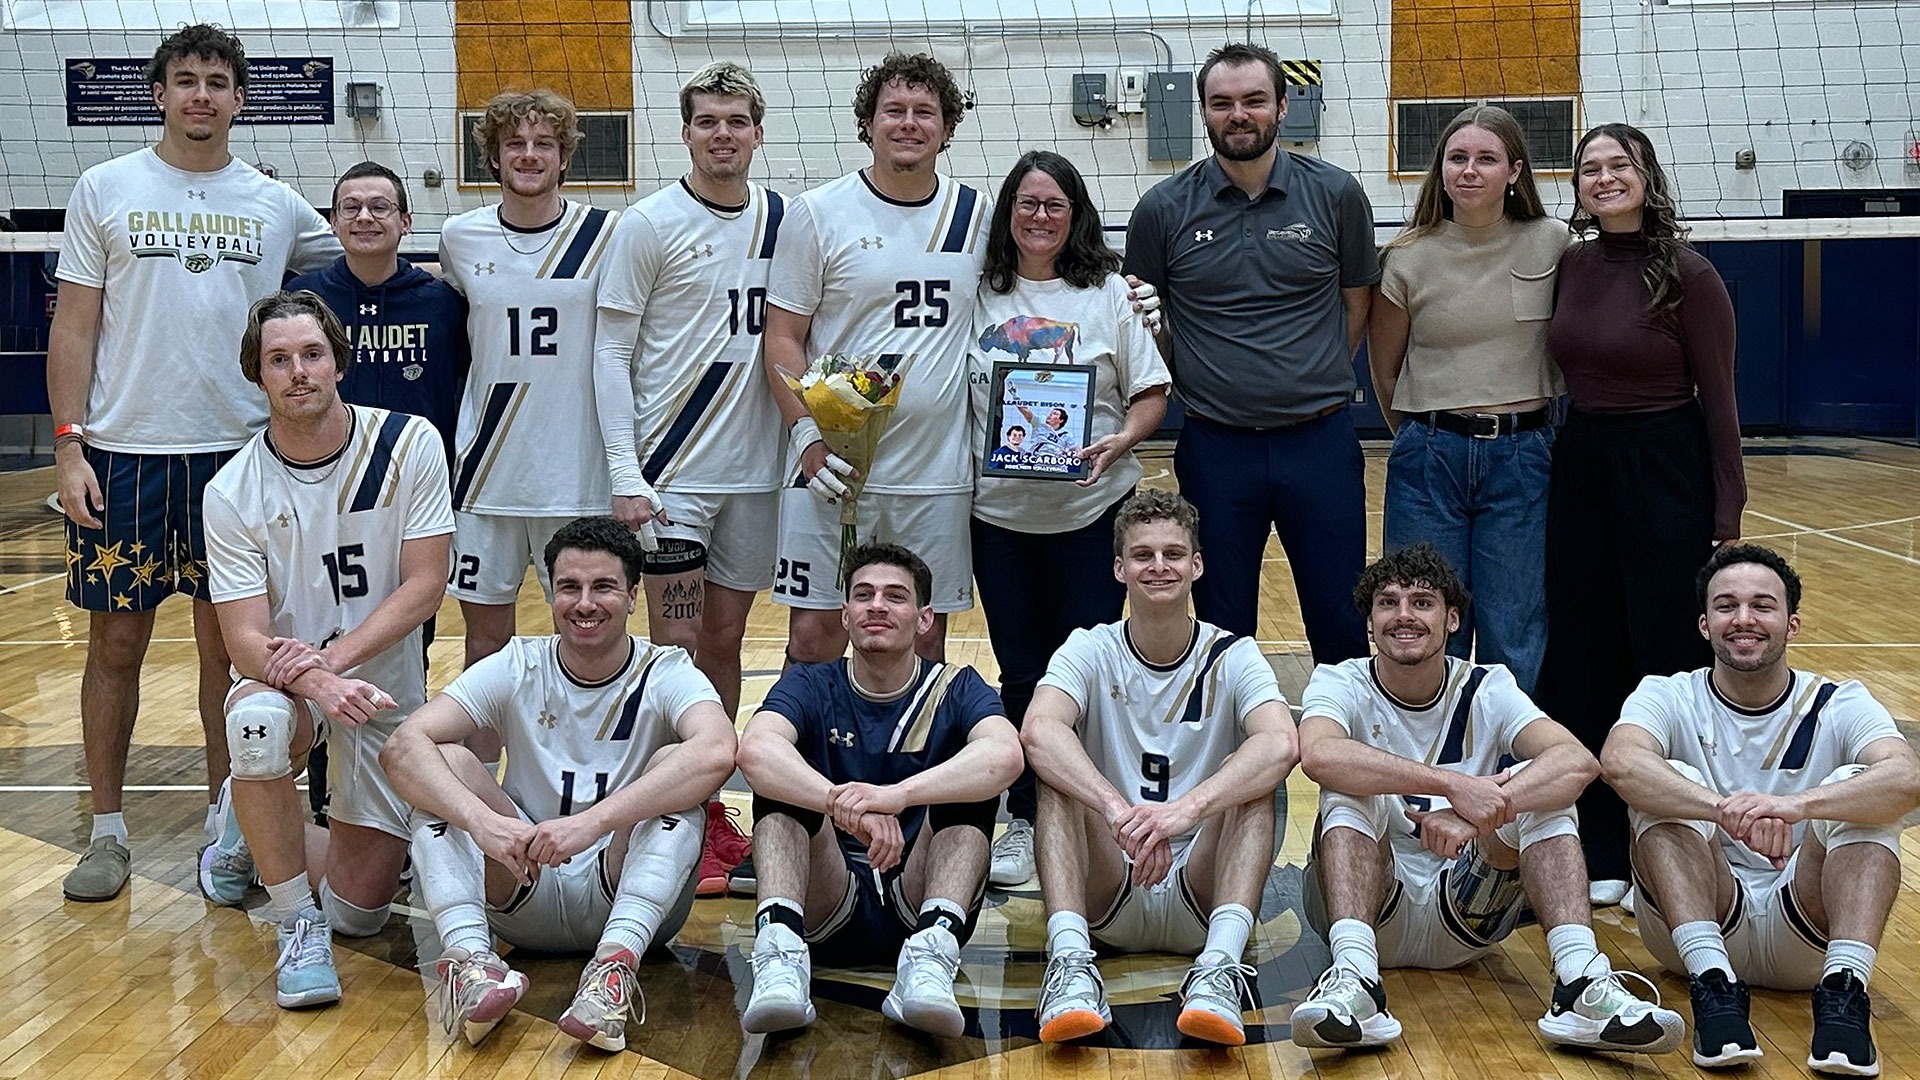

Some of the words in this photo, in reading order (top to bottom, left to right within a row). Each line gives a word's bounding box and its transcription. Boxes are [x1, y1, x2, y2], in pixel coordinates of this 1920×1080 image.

[128, 211, 264, 241] GALLAUDET
[129, 233, 263, 257] VOLLEYBALL
[728, 287, 767, 336] 10
[895, 279, 951, 328] 25
[506, 307, 558, 356] 12
[991, 453, 1019, 463] JACK
[1022, 455, 1081, 467] SCARBORO
[321, 543, 369, 606] 15
[774, 557, 811, 598] 25
[559, 770, 609, 816] 11
[1140, 752, 1169, 803] 9
